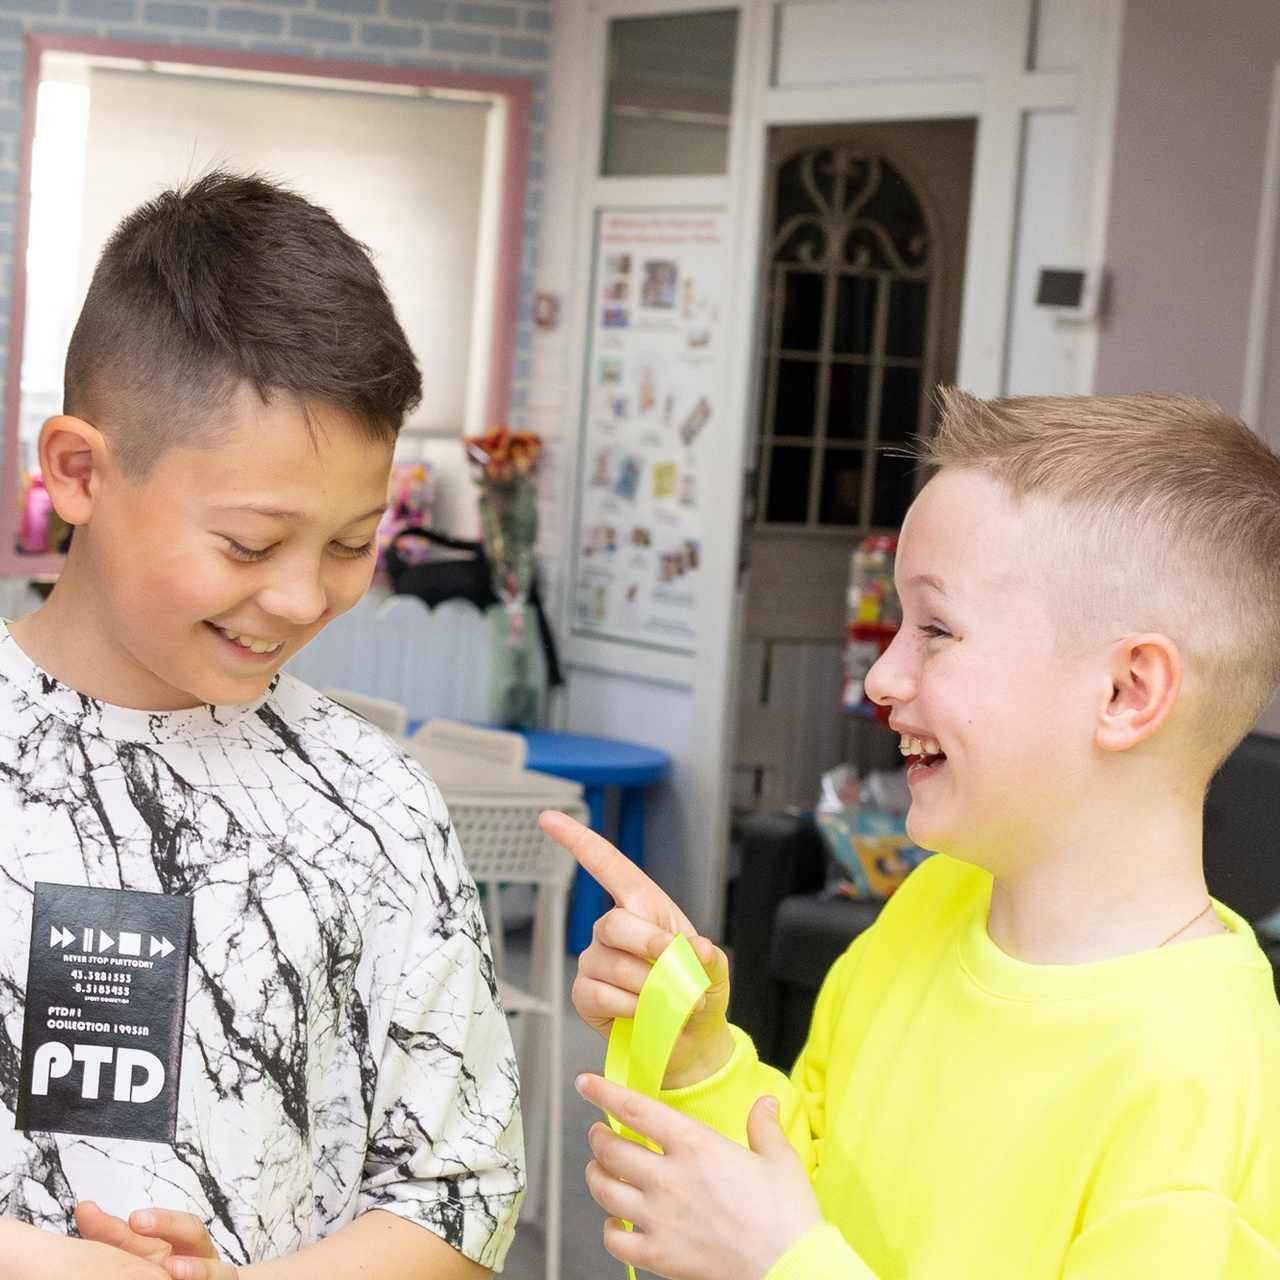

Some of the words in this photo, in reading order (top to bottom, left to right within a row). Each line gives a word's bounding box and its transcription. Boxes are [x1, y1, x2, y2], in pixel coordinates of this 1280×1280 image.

[63, 954, 87, 964] NEVER
[88, 956, 109, 965] STOP
[47, 1019, 111, 1033] COLLECTION
[31, 1041, 165, 1104] PTD
